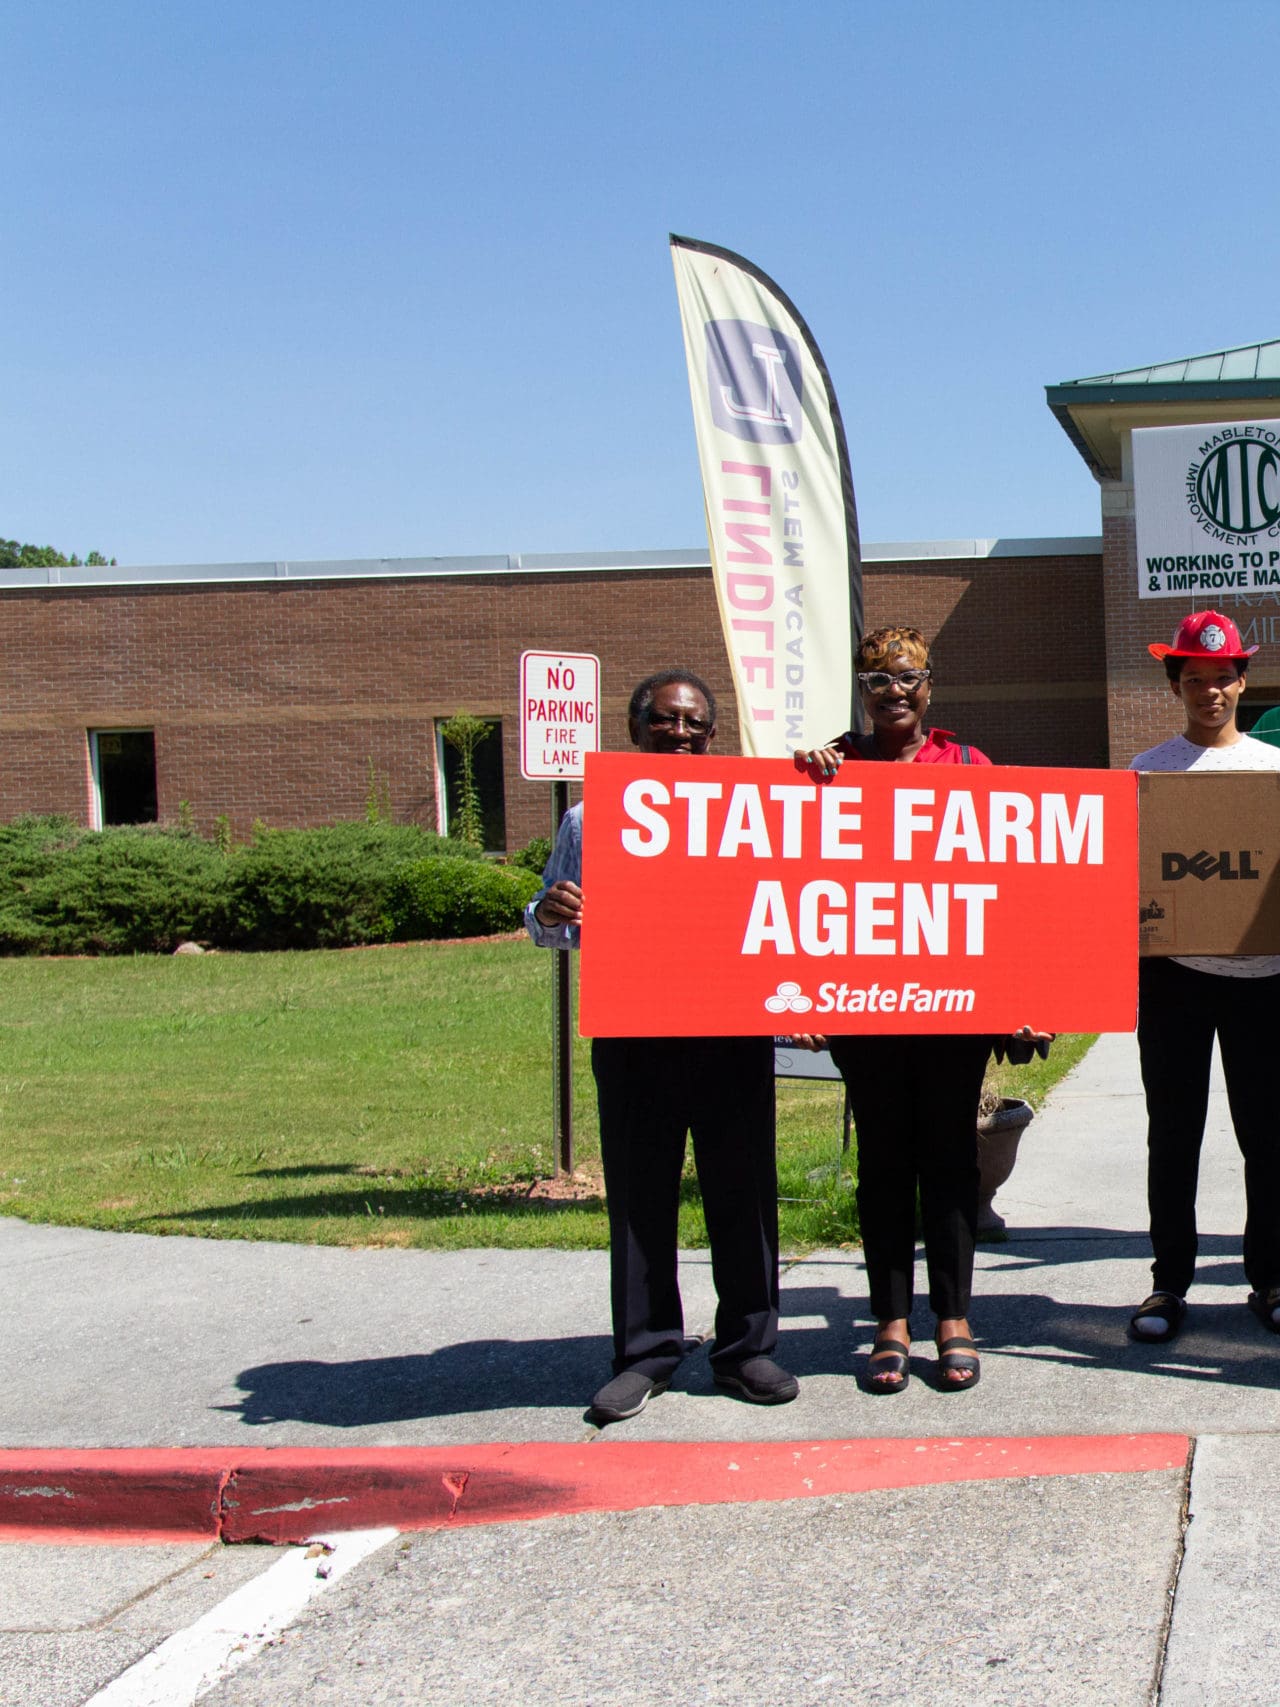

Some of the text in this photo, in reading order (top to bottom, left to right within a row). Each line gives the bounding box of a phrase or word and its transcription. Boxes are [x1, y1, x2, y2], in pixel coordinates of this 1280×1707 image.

[1185, 462, 1258, 546] IMPROVEMENT
[1146, 553, 1234, 574] WORKING
[1239, 551, 1264, 569] TO
[1148, 575, 1162, 591] &
[1167, 571, 1249, 590] IMPROVE
[547, 667, 575, 691] NO
[527, 698, 594, 724] PARKING
[546, 728, 577, 744] FIRE
[543, 750, 579, 765] LANE
[621, 779, 1104, 865] STATE FARM
[1162, 850, 1259, 882] DELL
[741, 879, 998, 956] AGENT
